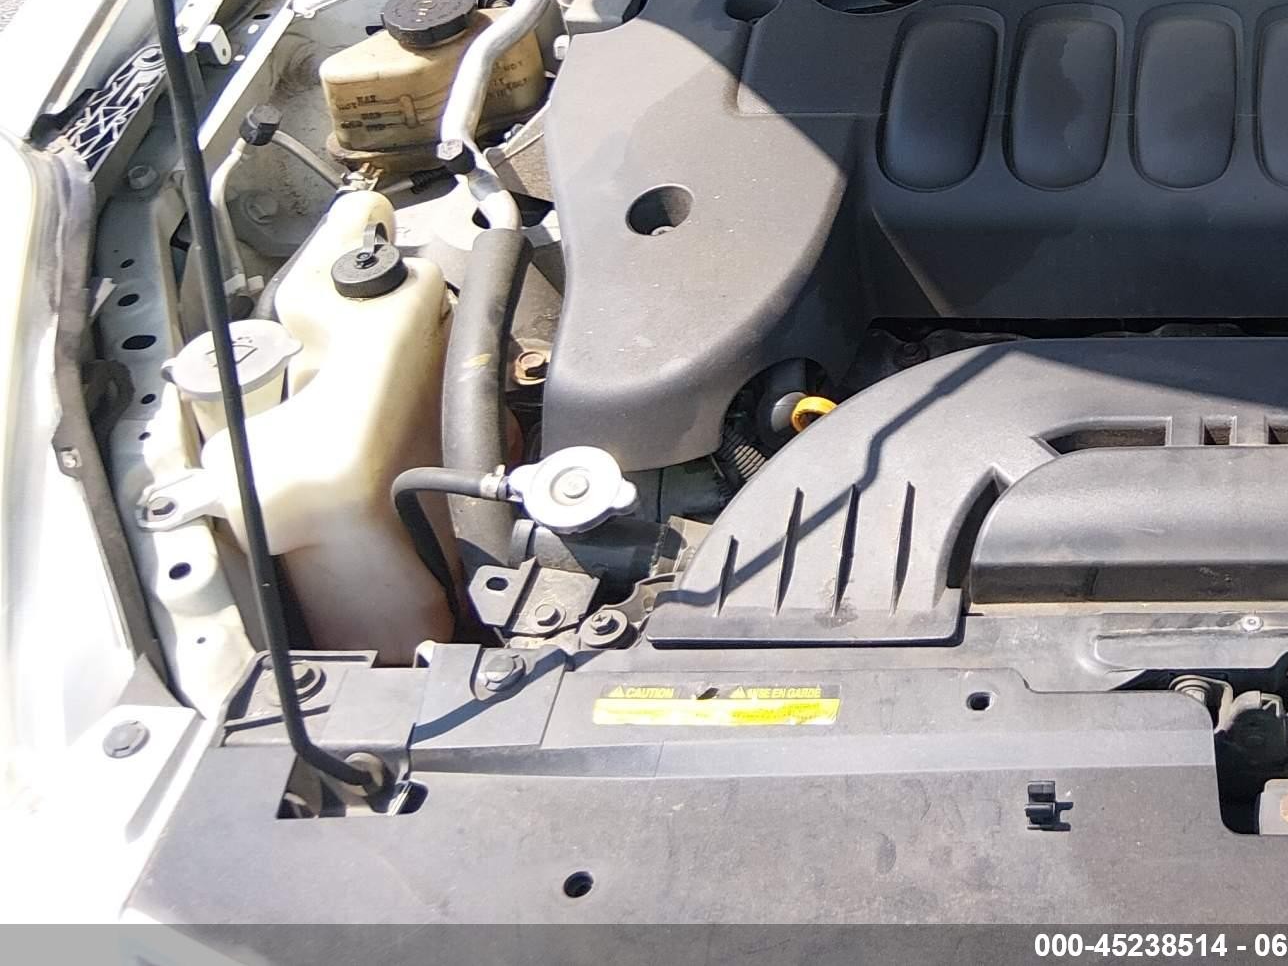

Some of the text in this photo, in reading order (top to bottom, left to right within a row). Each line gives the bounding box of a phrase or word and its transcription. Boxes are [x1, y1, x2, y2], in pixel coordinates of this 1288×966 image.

[626, 687, 674, 698] CAUTION
[771, 688, 786, 698] EN
[786, 687, 822, 698] GARDE
